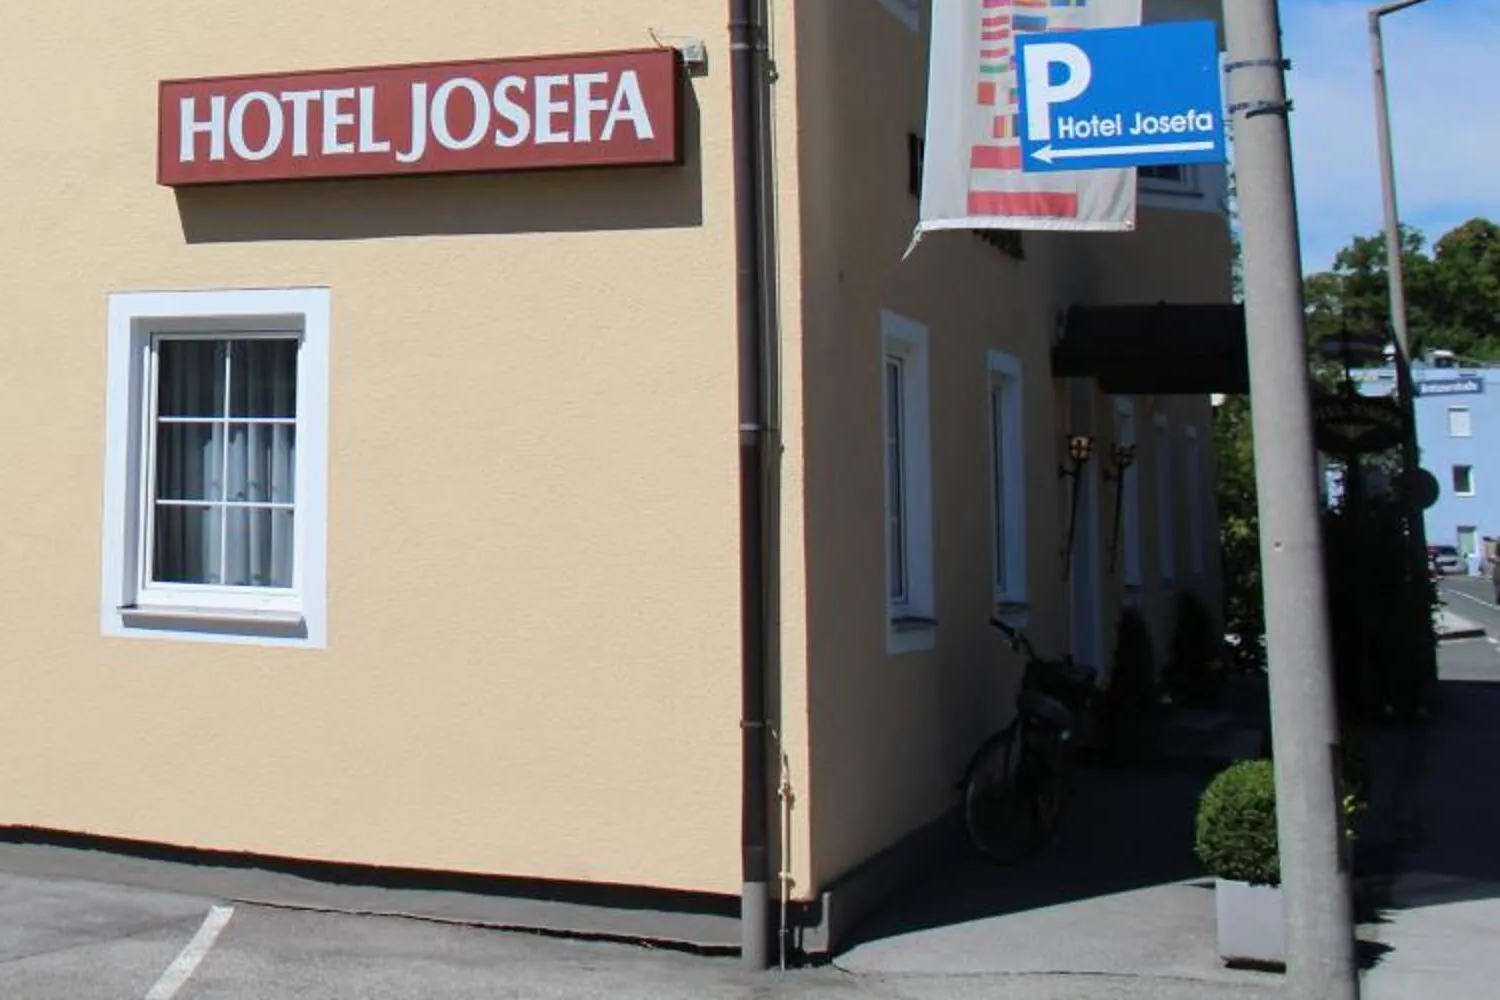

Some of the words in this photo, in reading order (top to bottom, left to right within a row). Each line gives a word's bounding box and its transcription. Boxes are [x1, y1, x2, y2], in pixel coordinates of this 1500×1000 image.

[179, 85, 391, 163] HOTEL
[396, 70, 655, 163] JOSEFA
[1023, 42, 1092, 141] P
[1057, 113, 1123, 139] Hotel
[1129, 109, 1214, 136] Josefa
